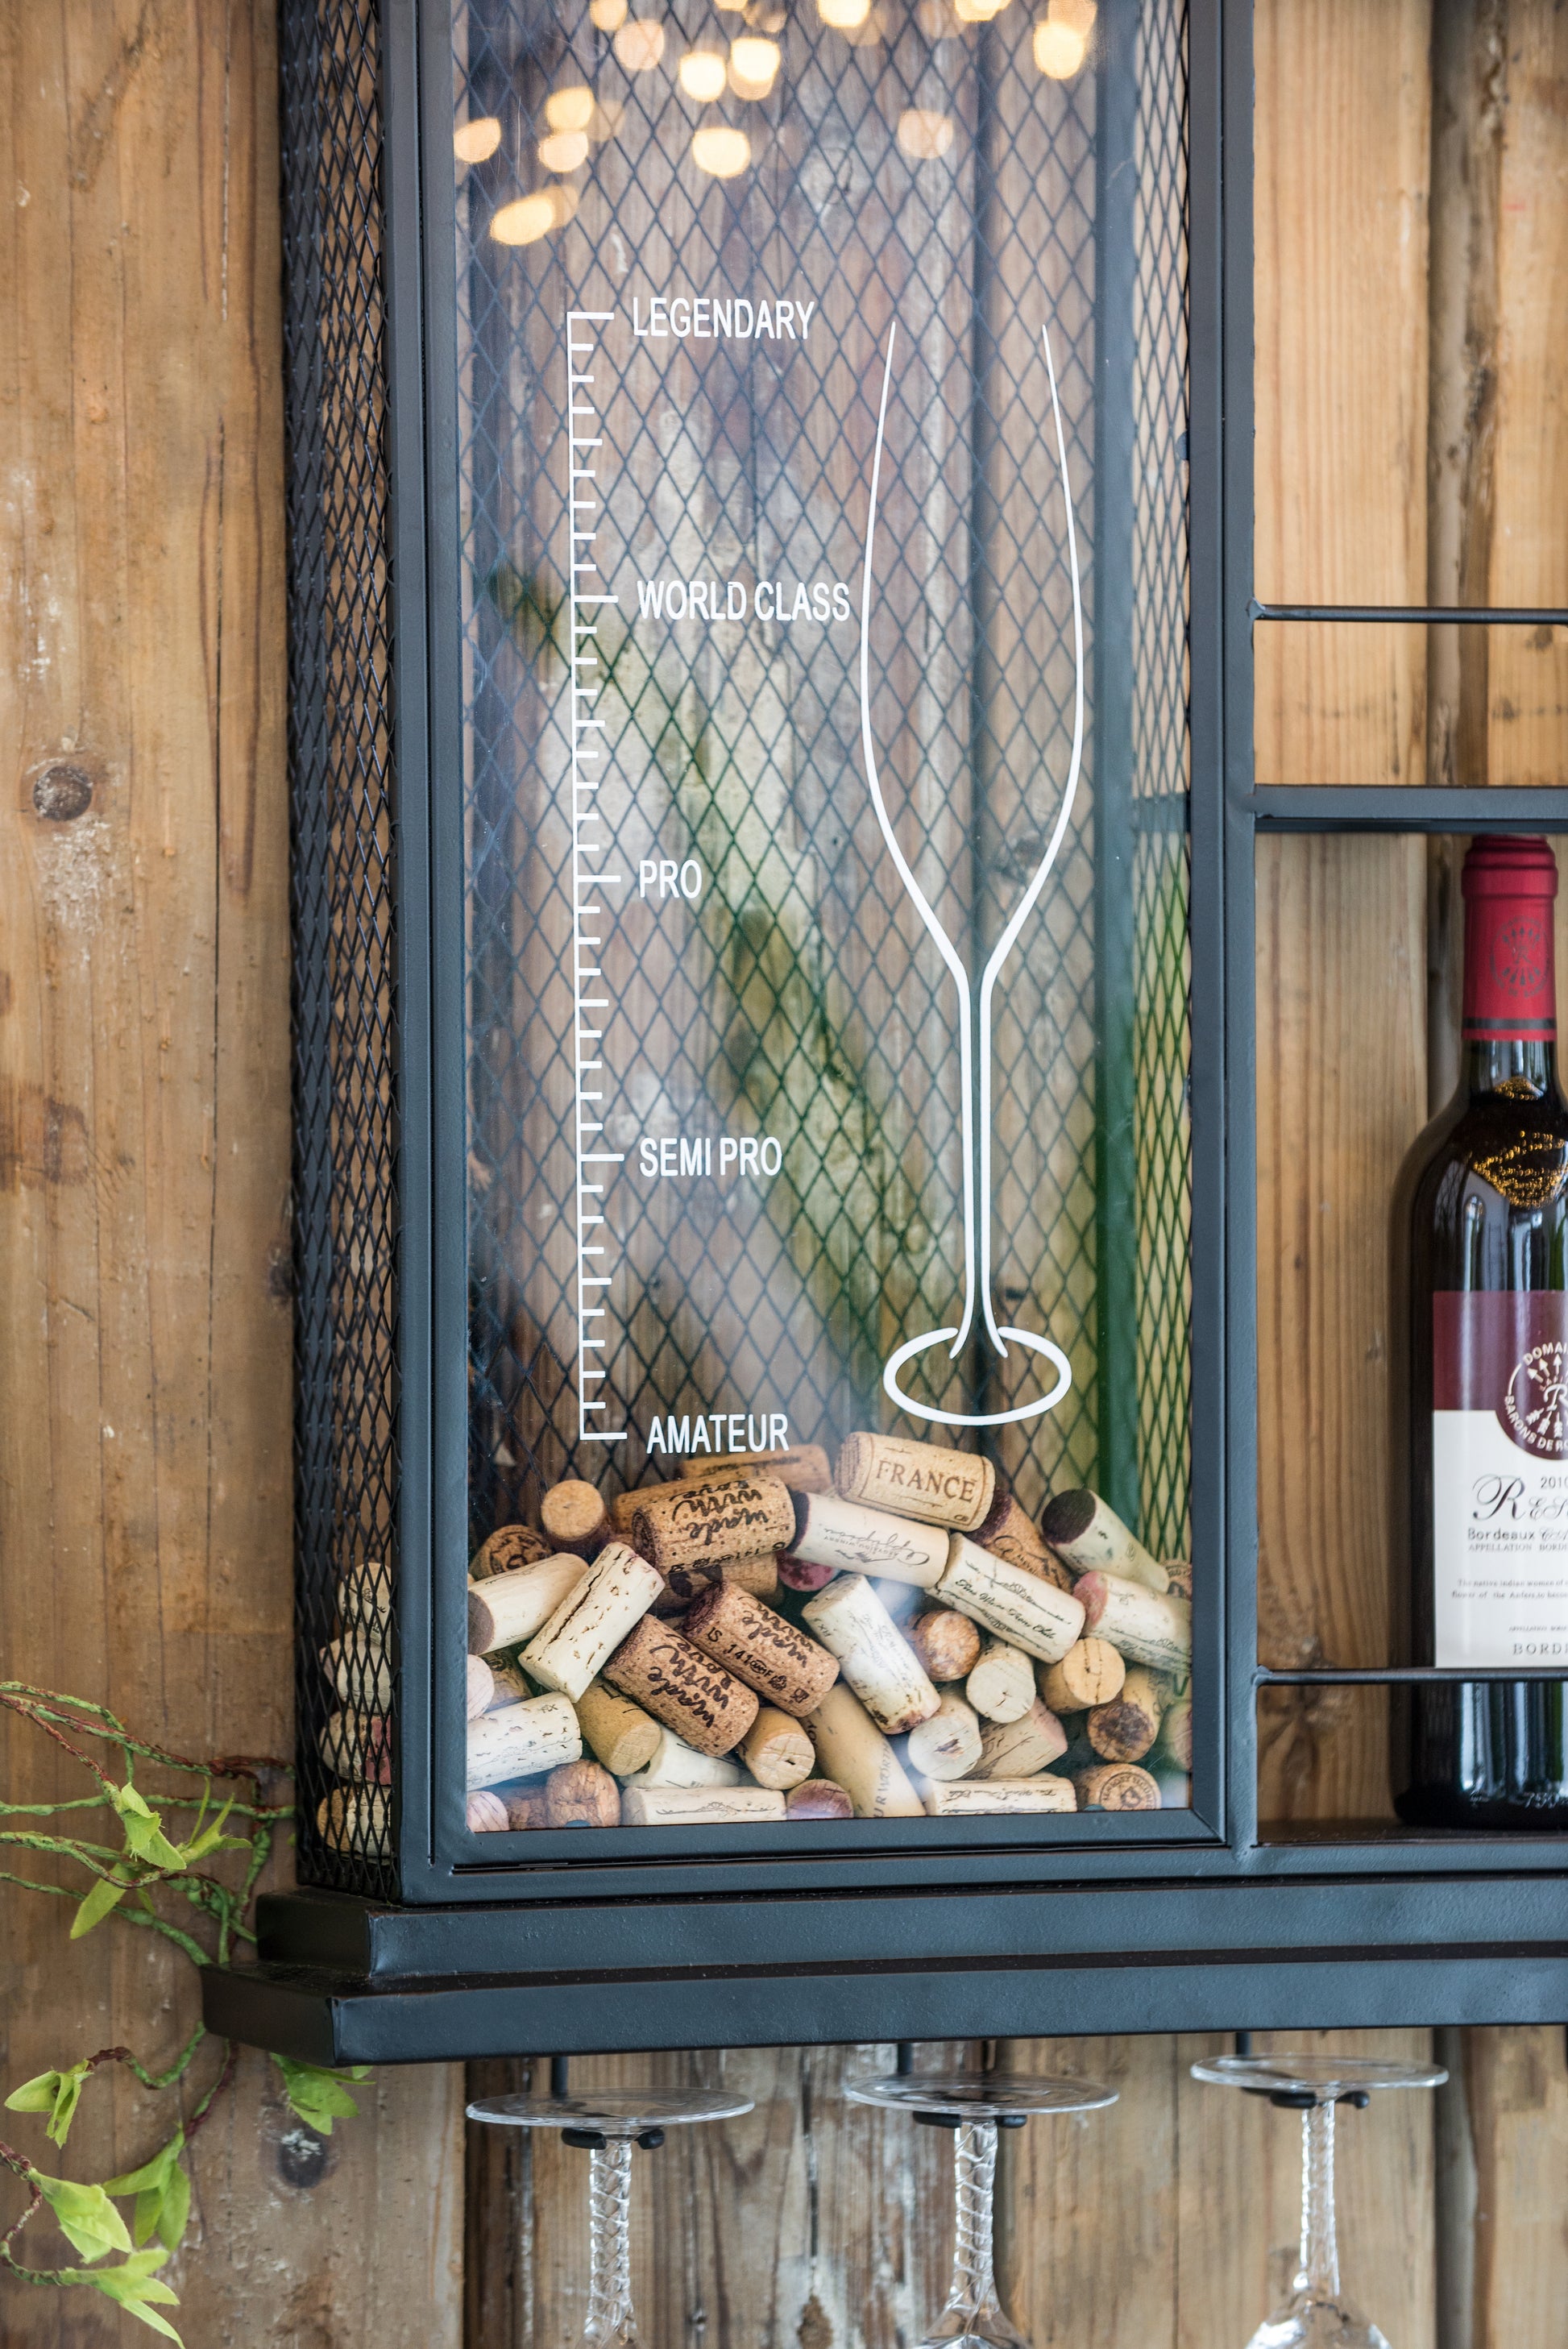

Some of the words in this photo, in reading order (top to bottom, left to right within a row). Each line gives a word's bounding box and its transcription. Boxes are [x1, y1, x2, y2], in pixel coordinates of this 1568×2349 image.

[633, 297, 815, 339] LEGENDARY
[637, 580, 747, 620] WORLD
[754, 580, 850, 621] CLASS
[640, 859, 702, 899] PRO
[640, 1137, 711, 1177] SEMI
[720, 1136, 782, 1176] PRO
[646, 1413, 790, 1454] AMATEUR
[1504, 1395, 1537, 1444] BARONS
[1537, 1437, 1553, 1451] DE
[876, 1459, 977, 1504] FRANCE
[672, 1489, 762, 1521] with
[686, 1507, 769, 1546] made
[1468, 1527, 1536, 1540] Bordeaux
[1469, 1543, 1532, 1551] APPELLATION
[741, 1610, 807, 1668] made
[1512, 1642, 1568, 1656] BORD
[647, 1666, 716, 1729] made
[649, 1644, 729, 1710] with
